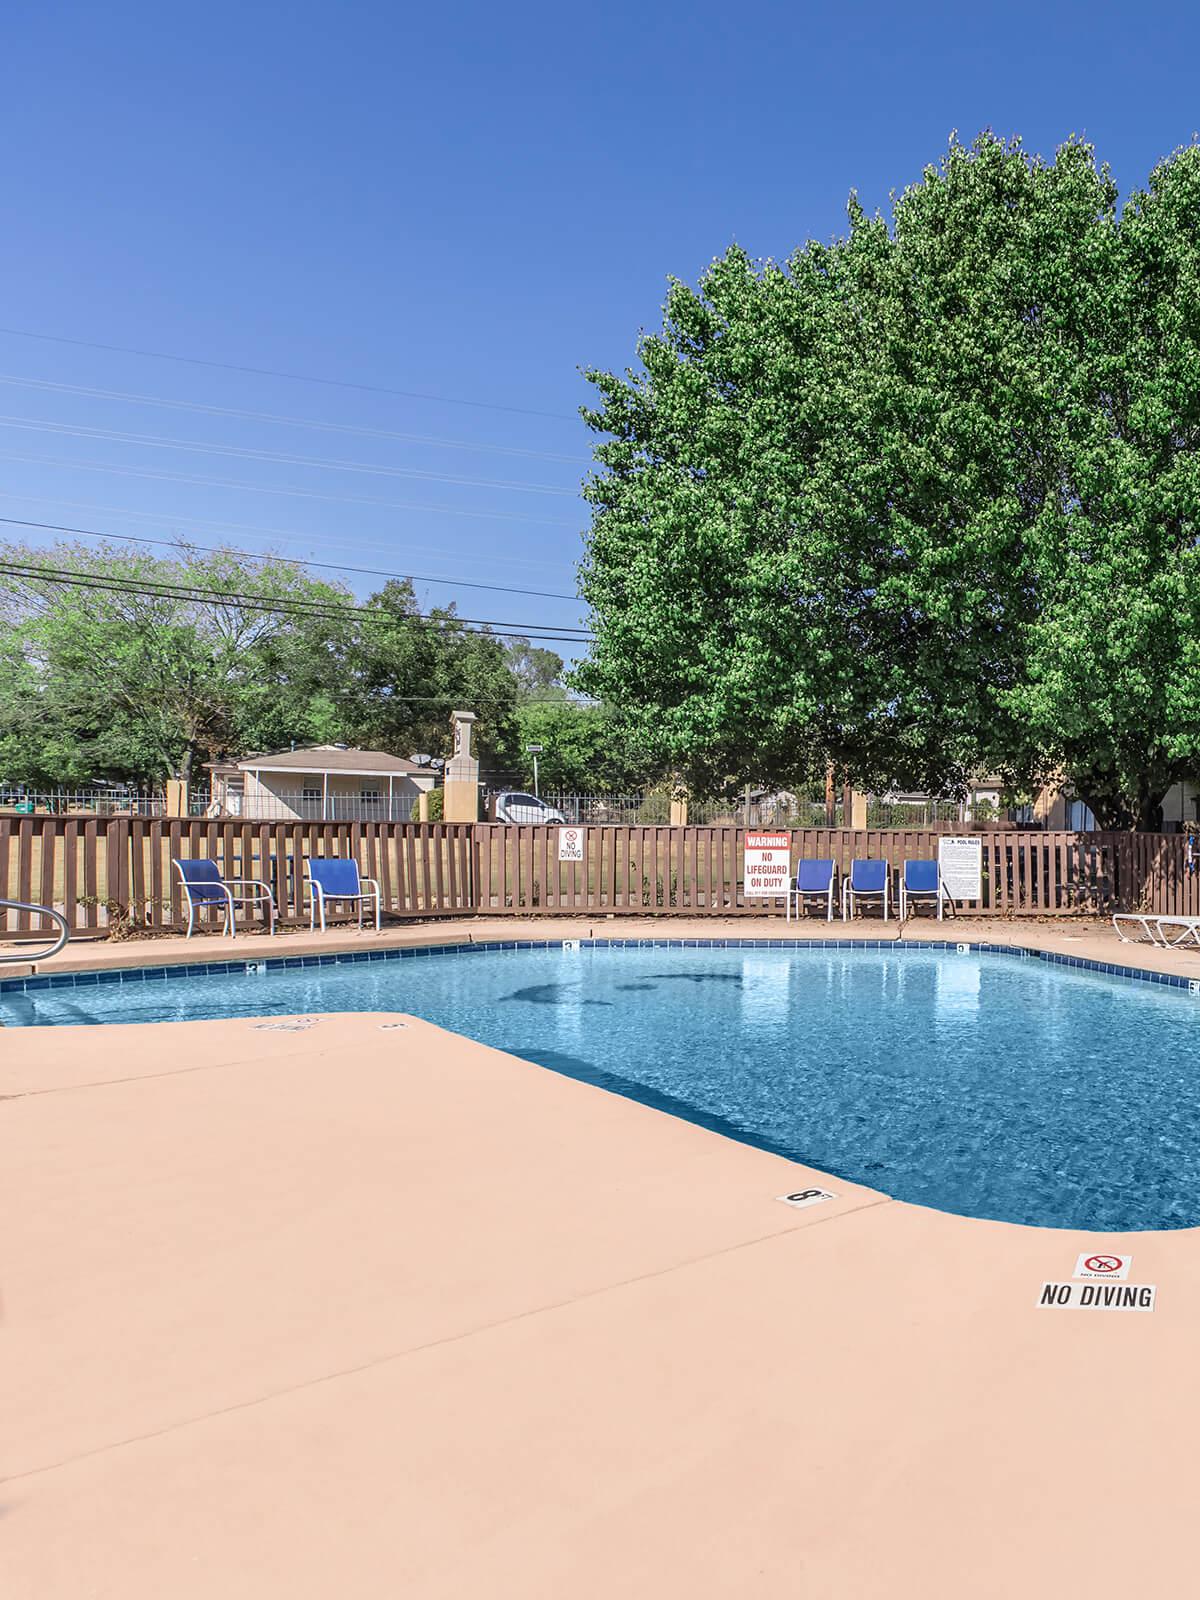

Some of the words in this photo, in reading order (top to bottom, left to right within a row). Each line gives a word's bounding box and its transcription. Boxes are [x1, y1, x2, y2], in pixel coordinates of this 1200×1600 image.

[566, 842, 576, 850] NO
[747, 836, 788, 847] WARNING
[560, 850, 582, 858] DIVING
[761, 852, 773, 861] NO
[746, 865, 788, 874] LIFEGUARD
[751, 878, 761, 887] ON
[763, 878, 783, 887] DUTY
[787, 1190, 822, 1201] 8
[1041, 1284, 1072, 1305] NO
[1079, 1286, 1152, 1307] DIVING
